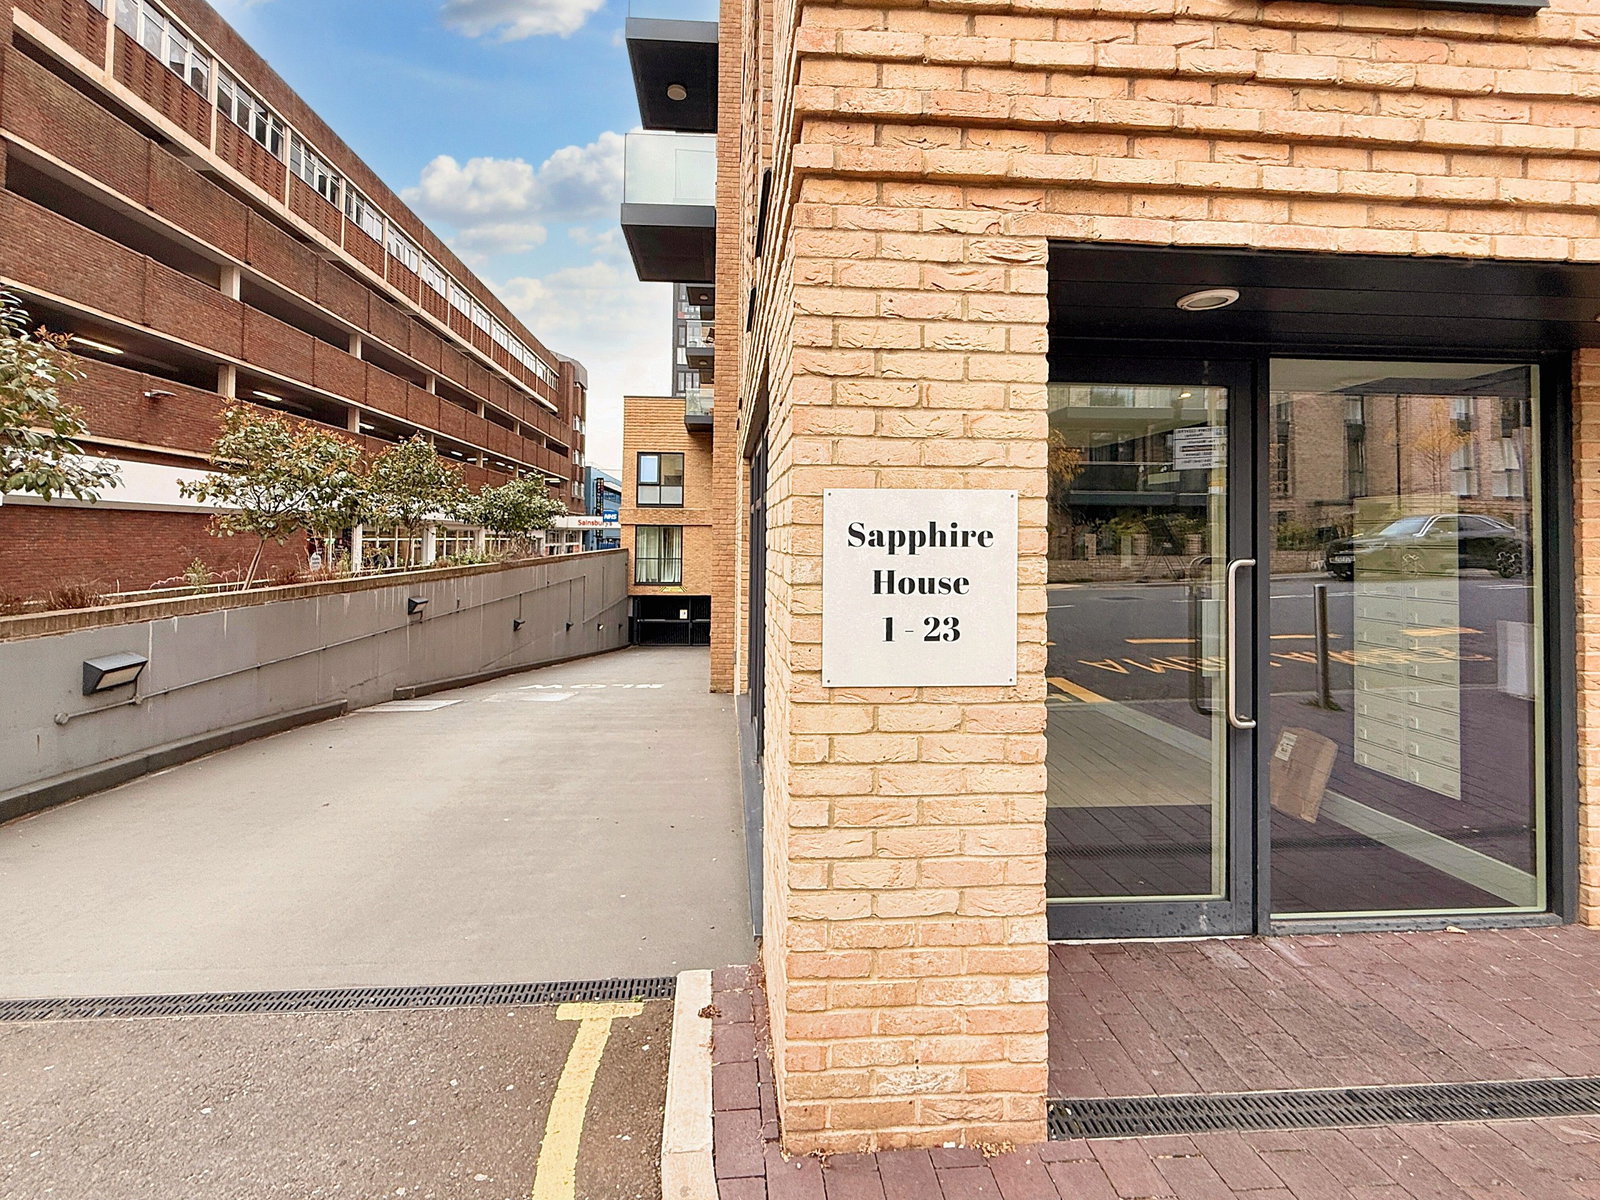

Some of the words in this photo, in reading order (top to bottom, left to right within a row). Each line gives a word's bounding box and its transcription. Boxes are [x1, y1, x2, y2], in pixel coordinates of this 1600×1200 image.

[847, 521, 994, 555] Sapphire
[872, 570, 970, 595] House
[923, 616, 961, 642] 23
